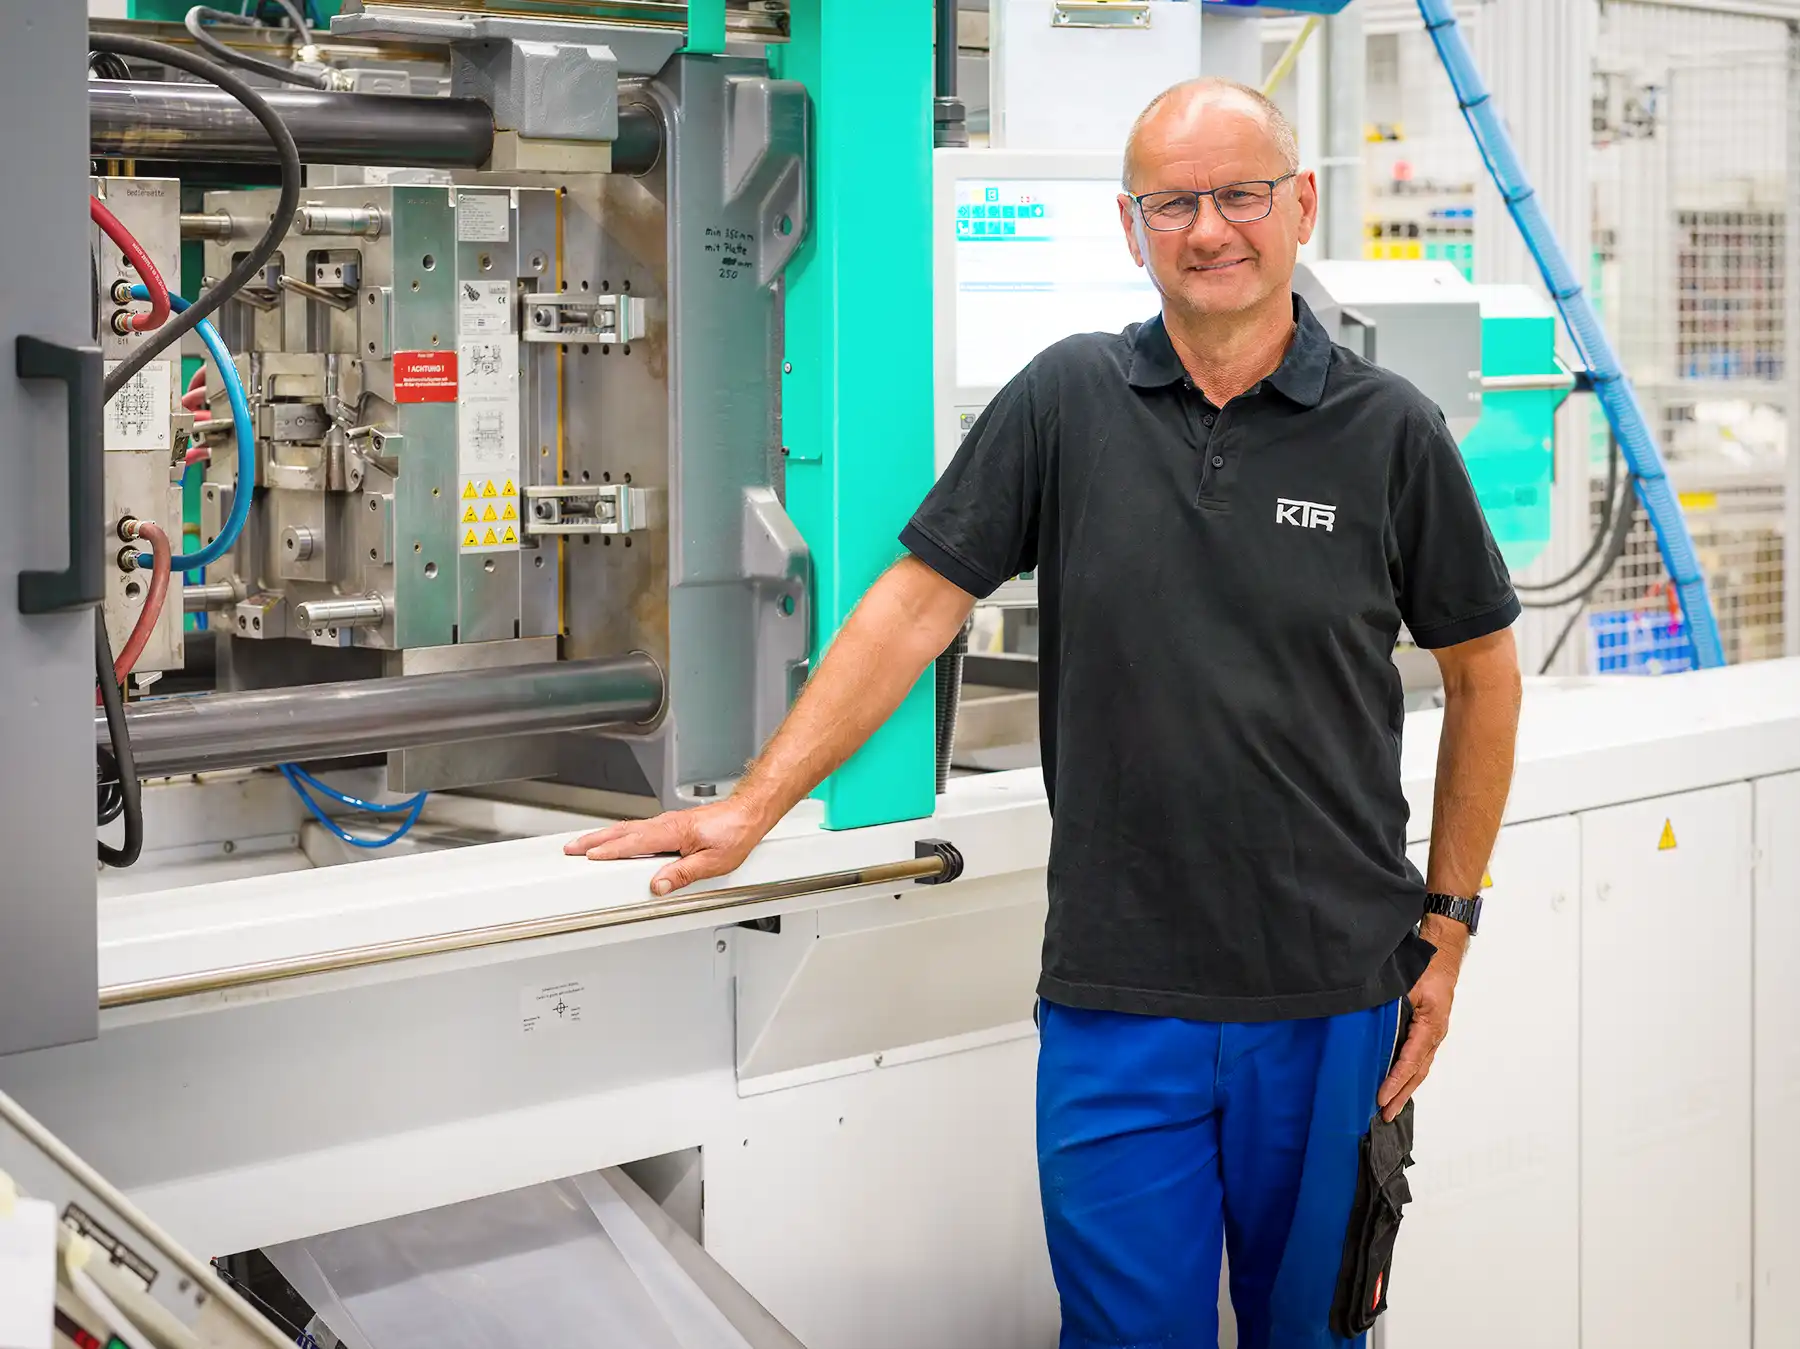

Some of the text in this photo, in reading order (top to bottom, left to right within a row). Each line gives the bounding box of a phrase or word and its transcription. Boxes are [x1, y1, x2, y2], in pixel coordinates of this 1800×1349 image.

[705, 244, 720, 252] mit
[719, 268, 738, 279] 250
[411, 364, 441, 373] ACHTUNG
[1276, 498, 1337, 532] KTR
